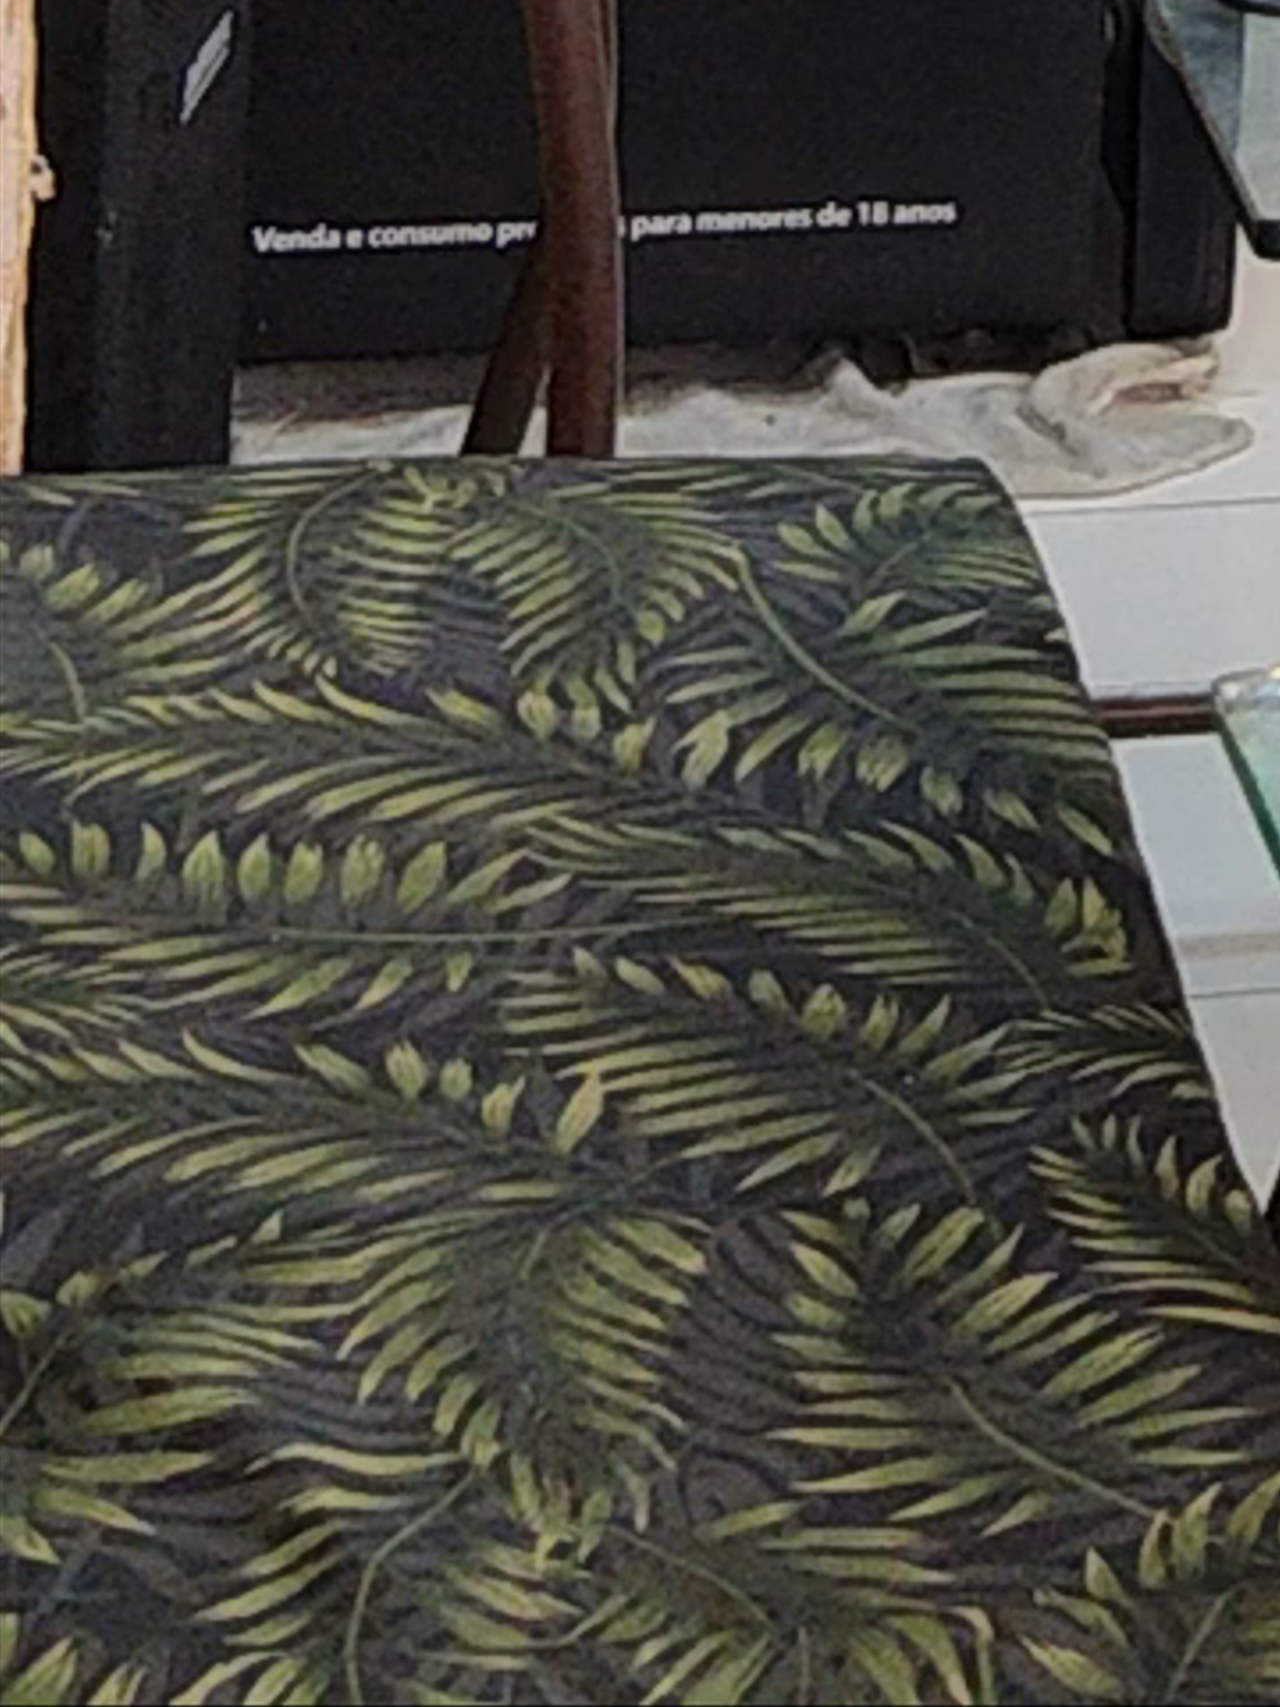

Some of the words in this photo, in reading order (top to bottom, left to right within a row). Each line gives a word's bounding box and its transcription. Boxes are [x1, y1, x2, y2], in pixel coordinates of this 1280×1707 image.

[252, 223, 341, 253] Venda
[346, 230, 363, 248] e
[368, 222, 493, 249] consumo
[630, 212, 692, 242] para
[696, 207, 813, 232] menores
[816, 201, 851, 228] de
[856, 201, 889, 226] 18
[894, 202, 957, 225] anos
